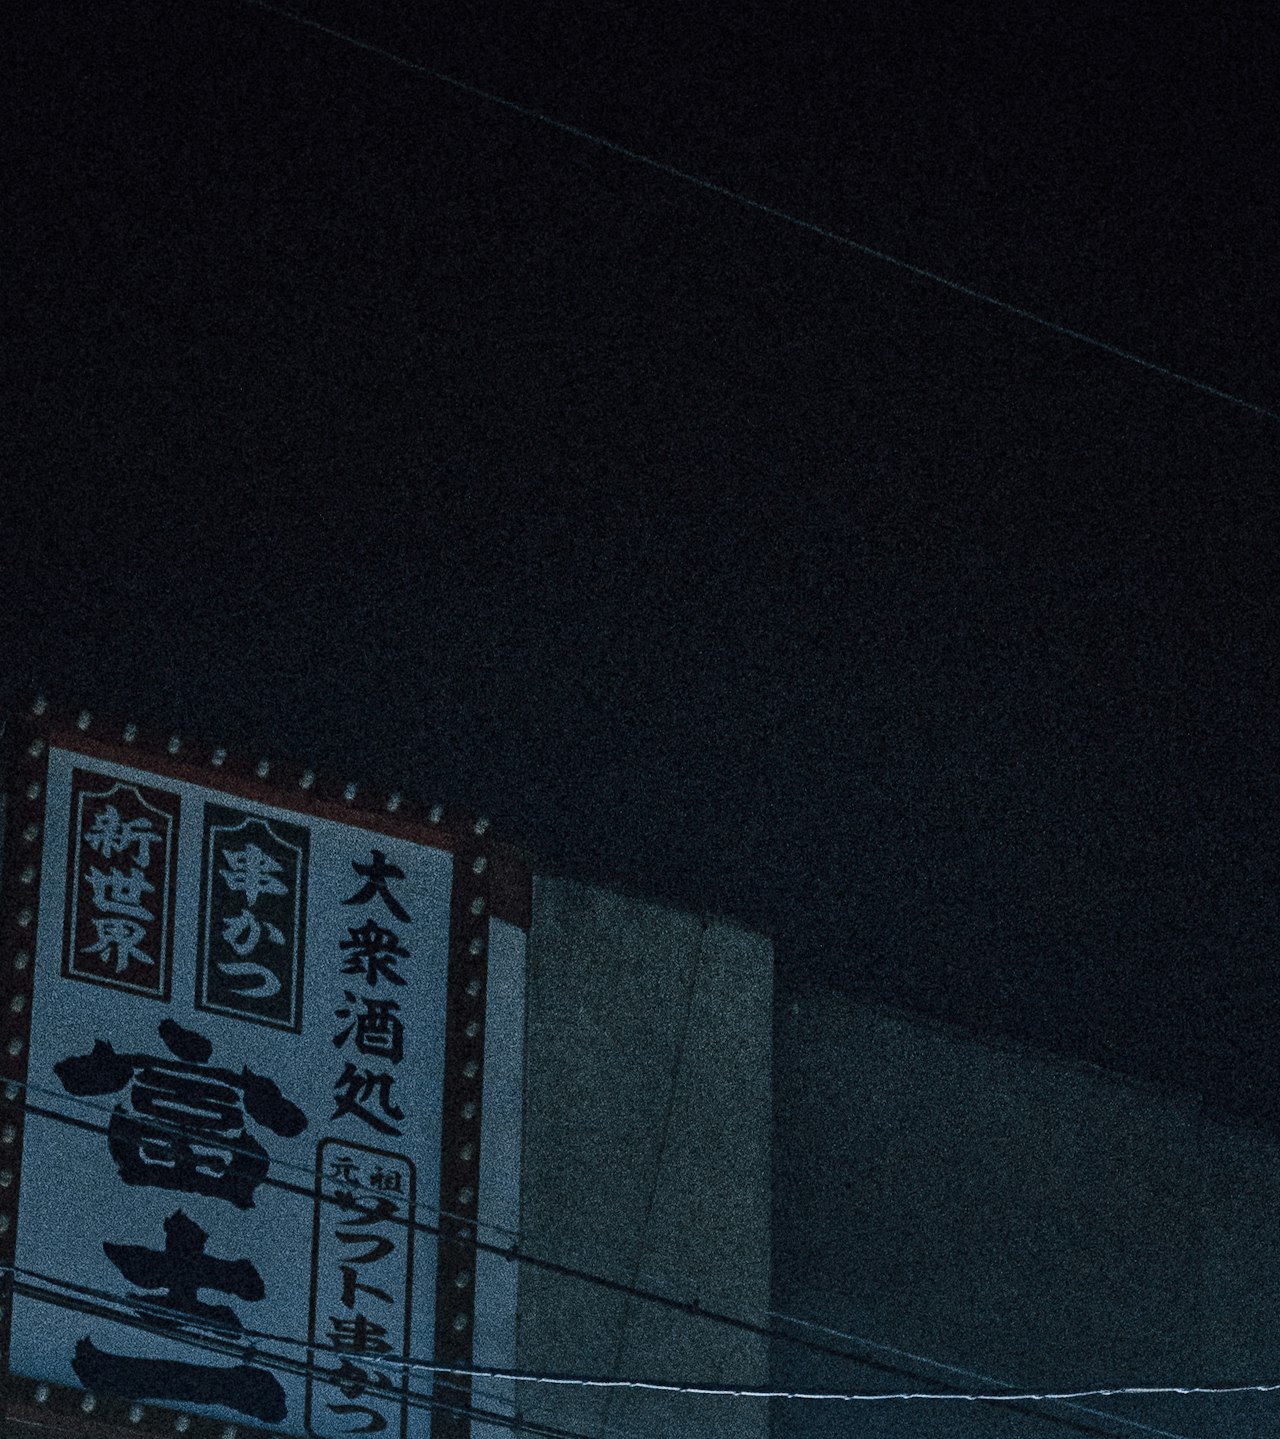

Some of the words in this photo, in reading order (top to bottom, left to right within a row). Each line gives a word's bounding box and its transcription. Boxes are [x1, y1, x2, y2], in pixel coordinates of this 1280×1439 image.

[84, 804, 161, 974] 新世界
[217, 844, 289, 1002] 串かつ
[331, 849, 414, 1139] 大衆酒処
